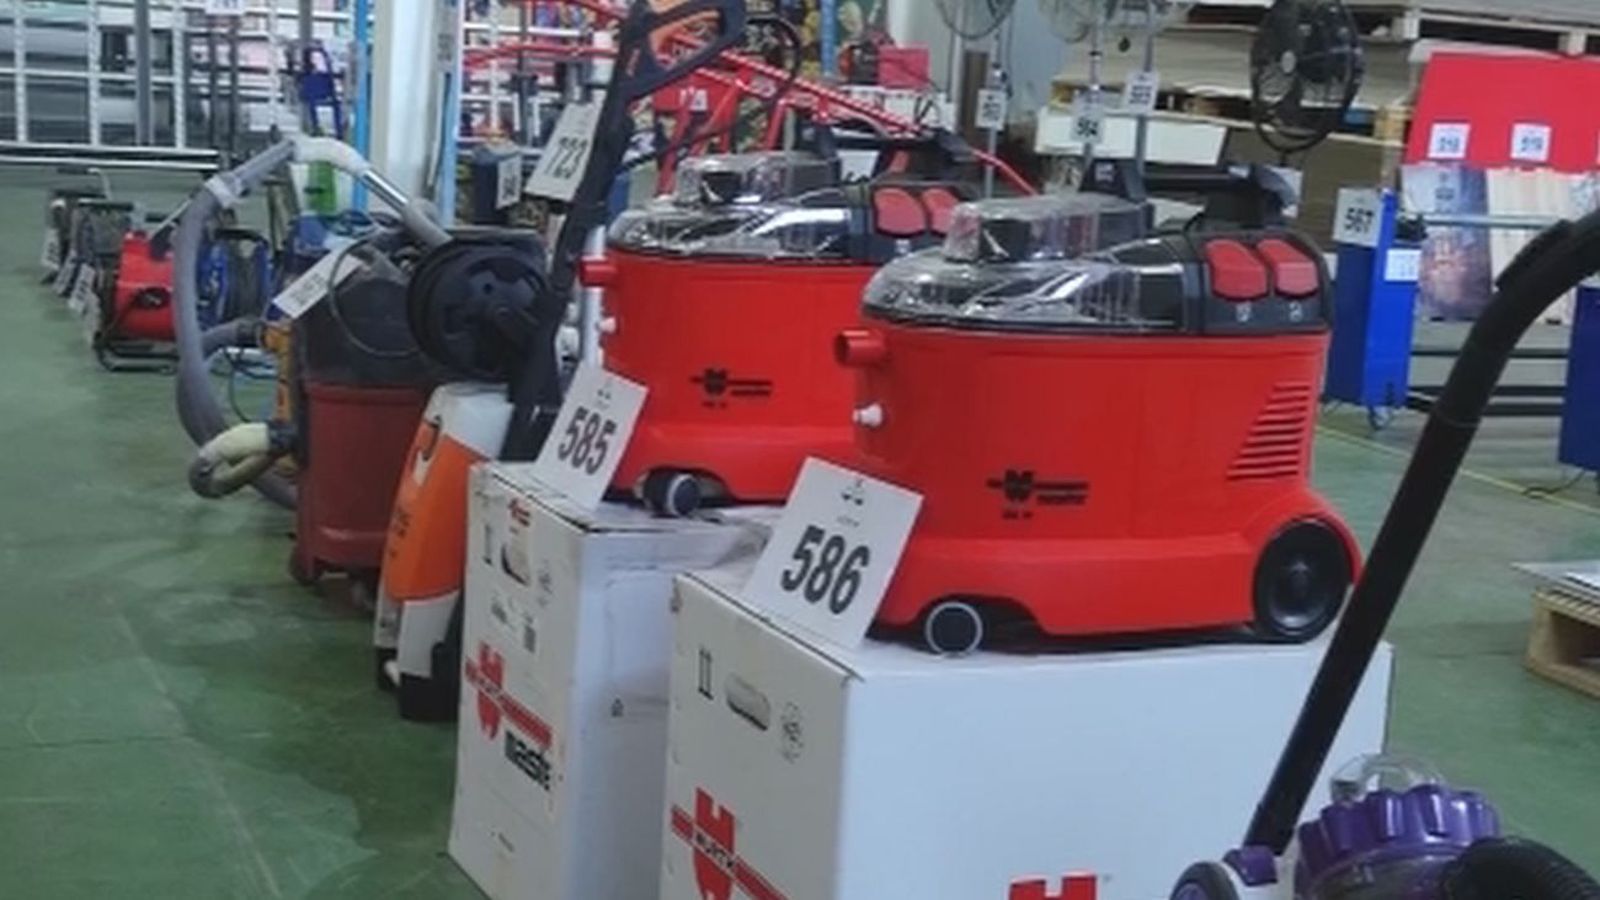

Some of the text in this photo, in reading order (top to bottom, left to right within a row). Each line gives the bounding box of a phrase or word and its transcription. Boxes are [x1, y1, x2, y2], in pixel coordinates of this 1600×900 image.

[543, 137, 588, 179] 723
[558, 405, 617, 476] 585
[780, 524, 870, 615] 586
